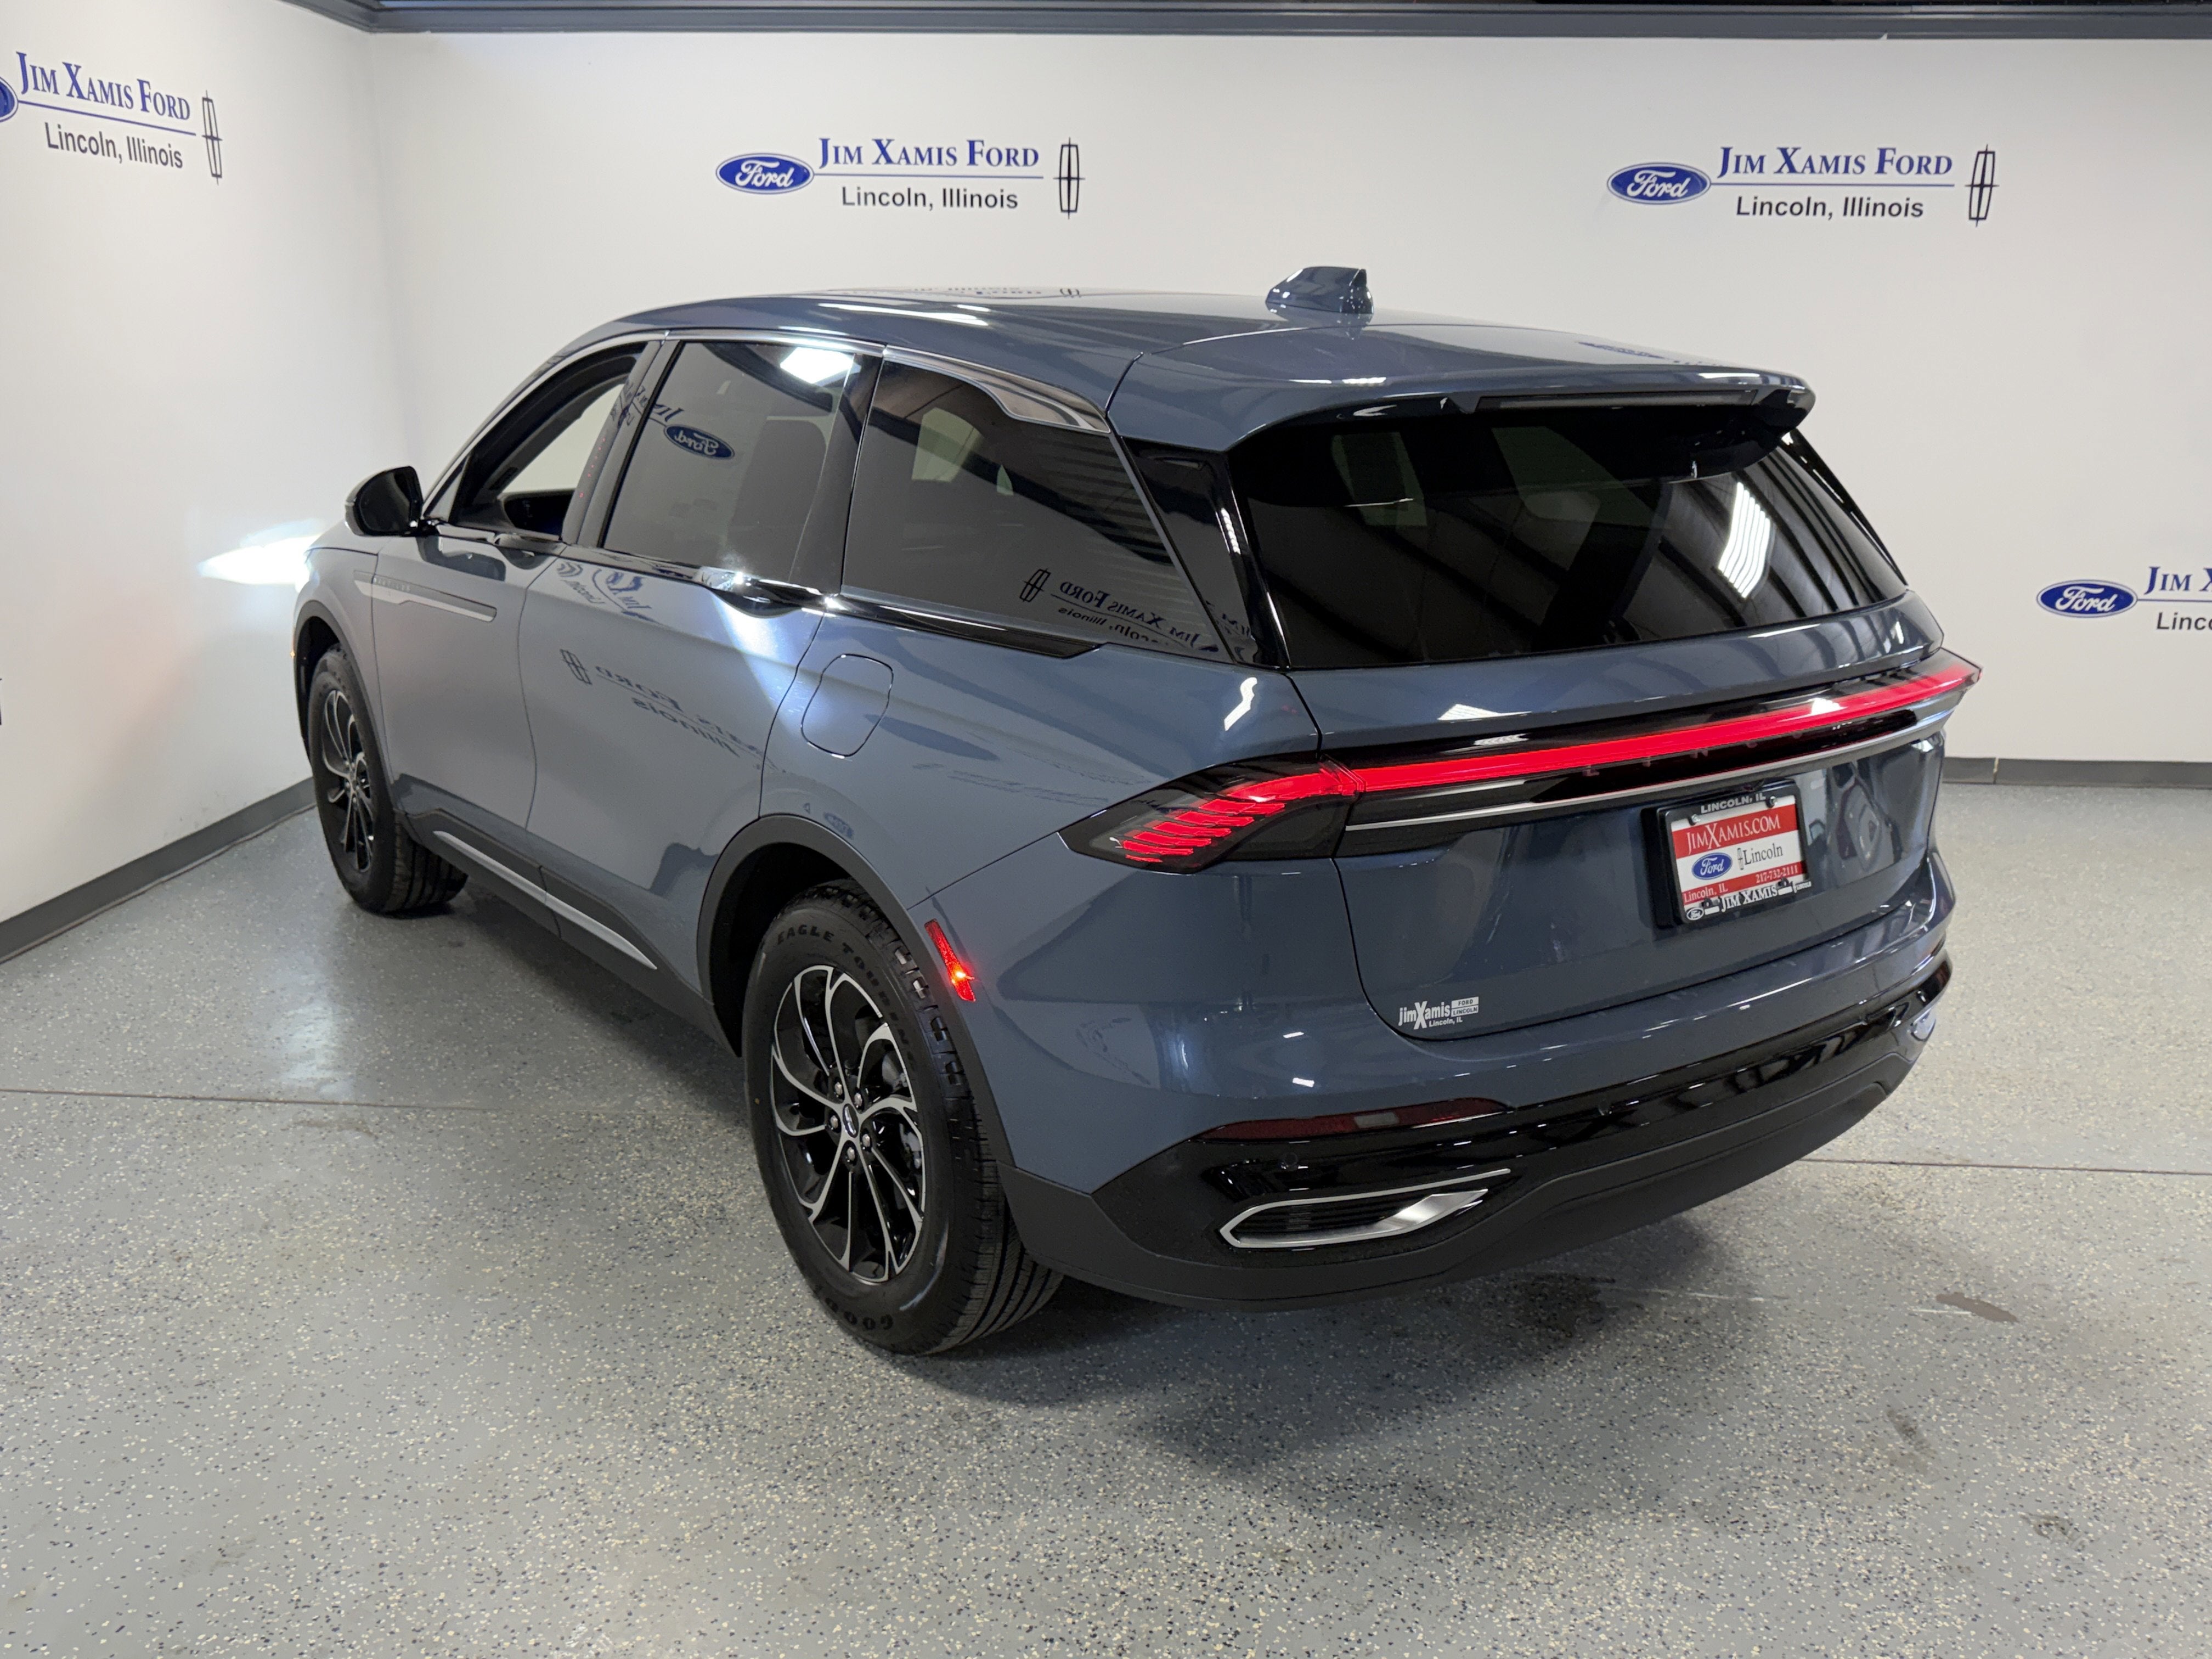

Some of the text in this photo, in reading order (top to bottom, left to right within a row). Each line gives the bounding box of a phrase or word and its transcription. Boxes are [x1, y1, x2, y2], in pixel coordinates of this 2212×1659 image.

[15, 51, 191, 121] JIM XAMIS FORD
[44, 122, 183, 169] Lincoln, Illinois
[819, 138, 1039, 169] JIM XAMIS FORD
[735, 160, 794, 187] Ford
[1717, 146, 1953, 179] JIM XAMIS FORD
[1627, 170, 1691, 197] Ford
[842, 186, 1018, 211] Lincoln, Illinois
[1736, 195, 1924, 221] Lincoln, Illinois
[2143, 566, 2192, 595] JIM
[2055, 585, 2118, 612] Ford
[2156, 612, 2212, 631] Linc
[1756, 793, 1767, 803] IL
[1700, 856, 1725, 876] Ford
[1742, 842, 1784, 866] Lincoln
[1756, 864, 1799, 884] 217-732-2111
[1719, 883, 1728, 893] IL
[1720, 895, 1741, 912] JIM
[1742, 884, 1778, 906] XAMIS
[777, 924, 835, 945] EAGLE
[1398, 1001, 1451, 1030] jimXamis
[1429, 1017, 1455, 1028] Lincoln,
[1453, 1007, 1478, 1015] LINCOLN
